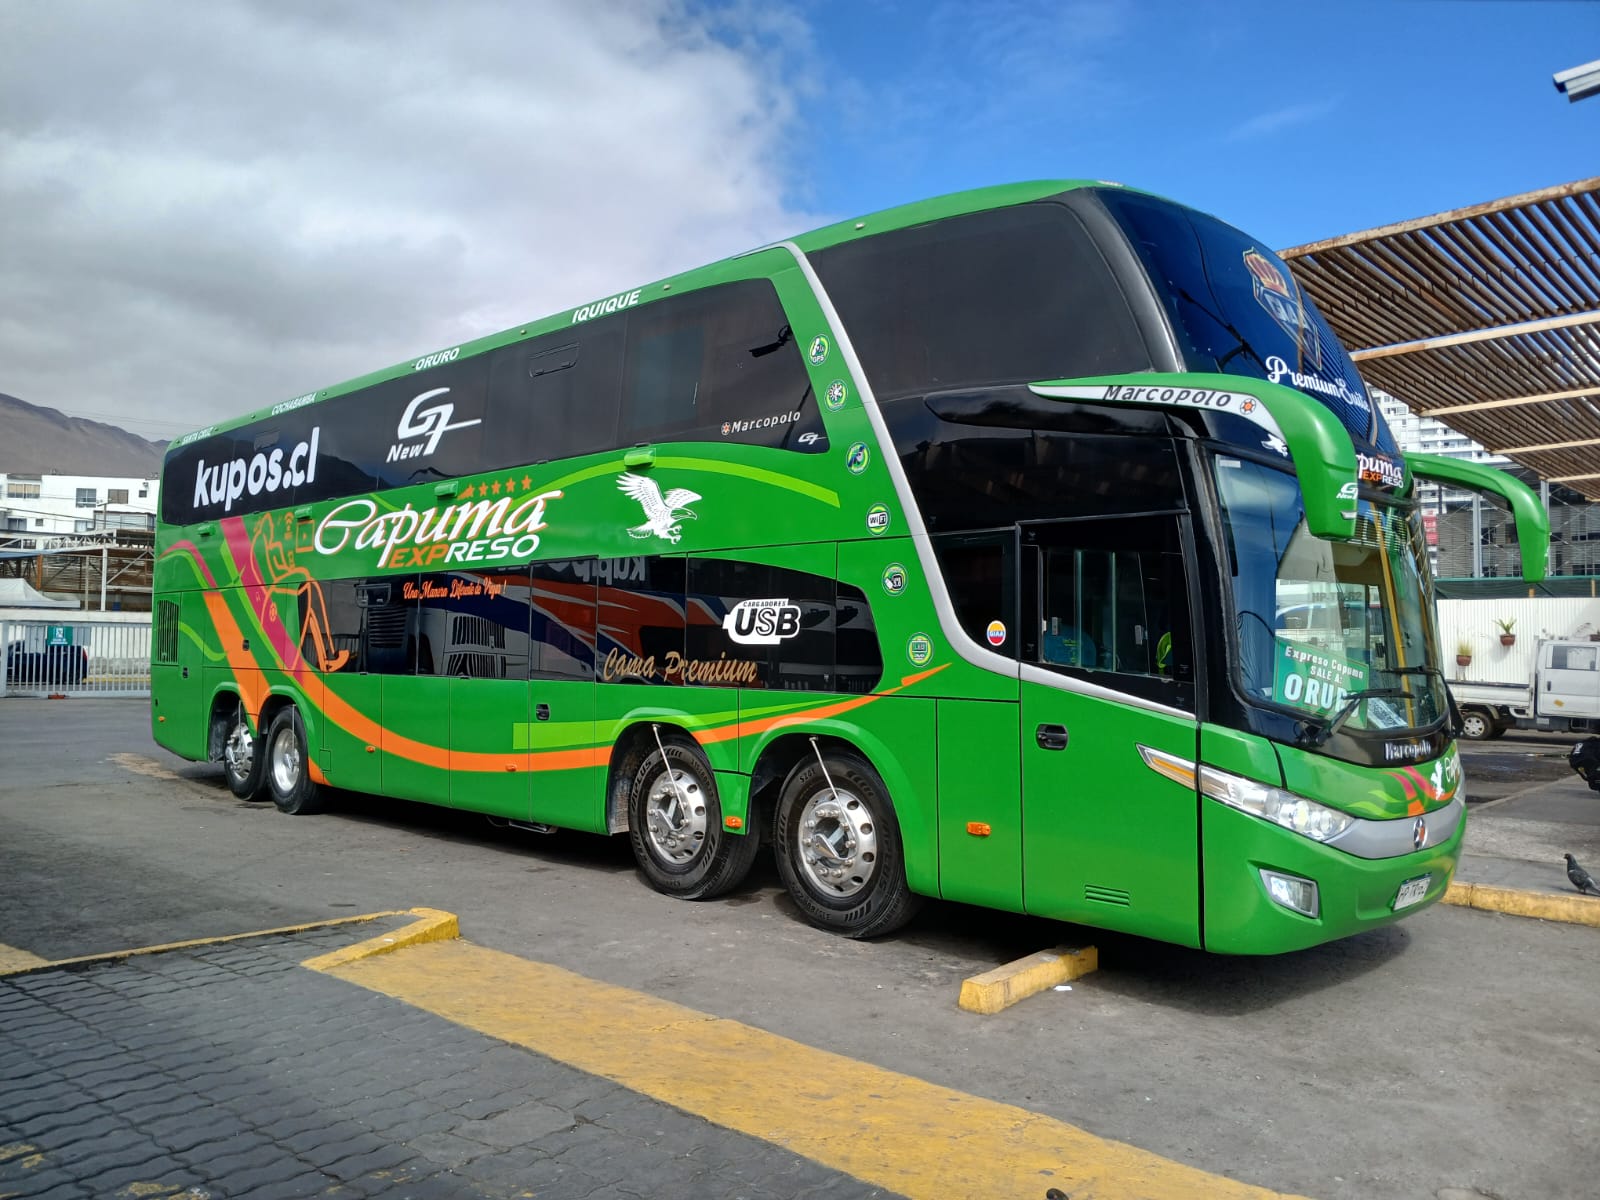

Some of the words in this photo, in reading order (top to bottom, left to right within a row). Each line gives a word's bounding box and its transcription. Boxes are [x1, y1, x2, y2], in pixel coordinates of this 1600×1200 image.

[572, 290, 641, 323] IQUIQUE
[416, 348, 460, 370] ORURO
[812, 355, 825, 363] GPS
[1265, 356, 1341, 398] Premium
[271, 392, 317, 415] COCHABAMBA
[1103, 385, 1231, 407] Marcopolo
[730, 410, 800, 433] Marcopolo
[386, 443, 424, 463] New
[1355, 452, 1402, 479] puma
[193, 426, 320, 512] kupos.cl
[1362, 471, 1404, 488] EXPRESO
[314, 490, 564, 568] Capuma
[389, 535, 540, 568] EXPRESO
[734, 607, 800, 637] USB
[603, 647, 656, 681] Cama
[664, 651, 757, 682] Premium
[1285, 645, 1328, 666] Expreso
[1331, 659, 1364, 679] Capuma
[1310, 665, 1332, 680] SALE
[1284, 673, 1360, 718] ORUR
